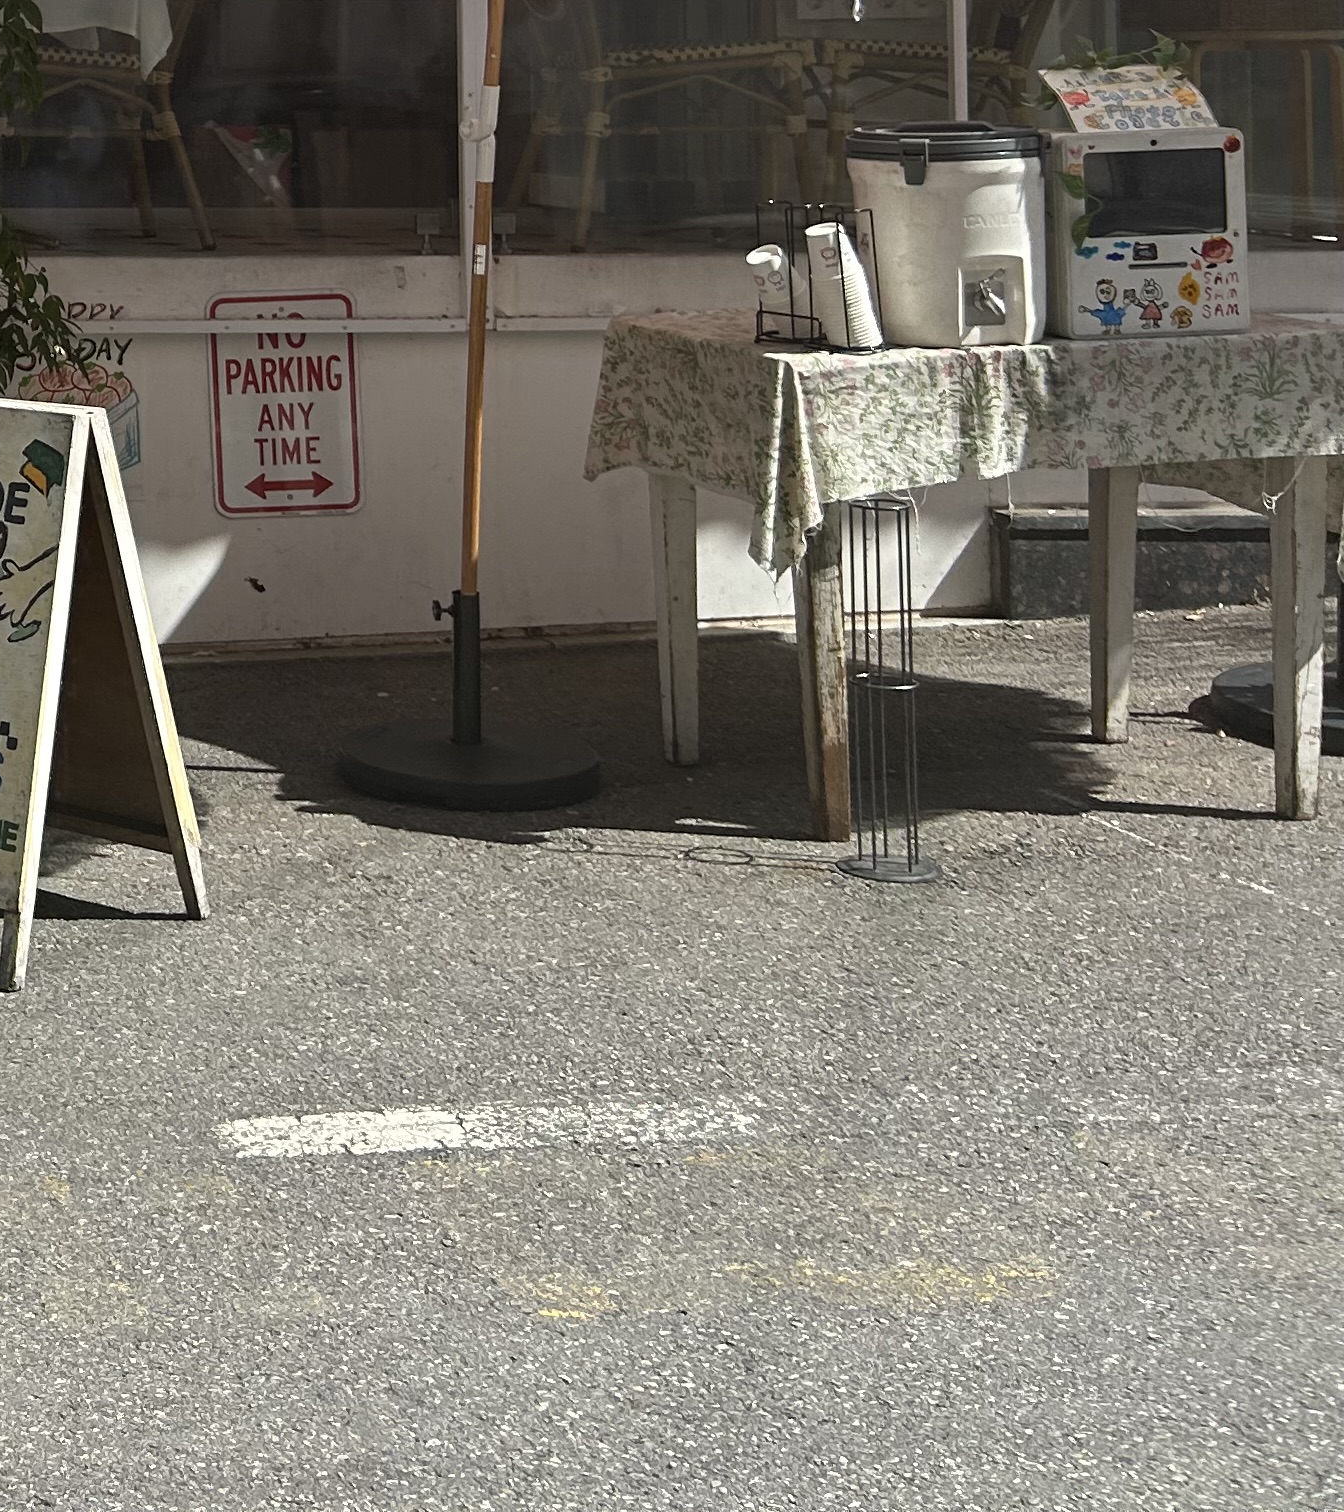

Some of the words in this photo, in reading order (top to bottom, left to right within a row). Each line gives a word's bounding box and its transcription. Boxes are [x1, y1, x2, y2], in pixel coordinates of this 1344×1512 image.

[1204, 271, 1240, 285] SAM
[1202, 304, 1240, 319] SAM
[225, 355, 342, 395] PARKING
[258, 402, 315, 431] ANY
[254, 436, 321, 466] TIME
